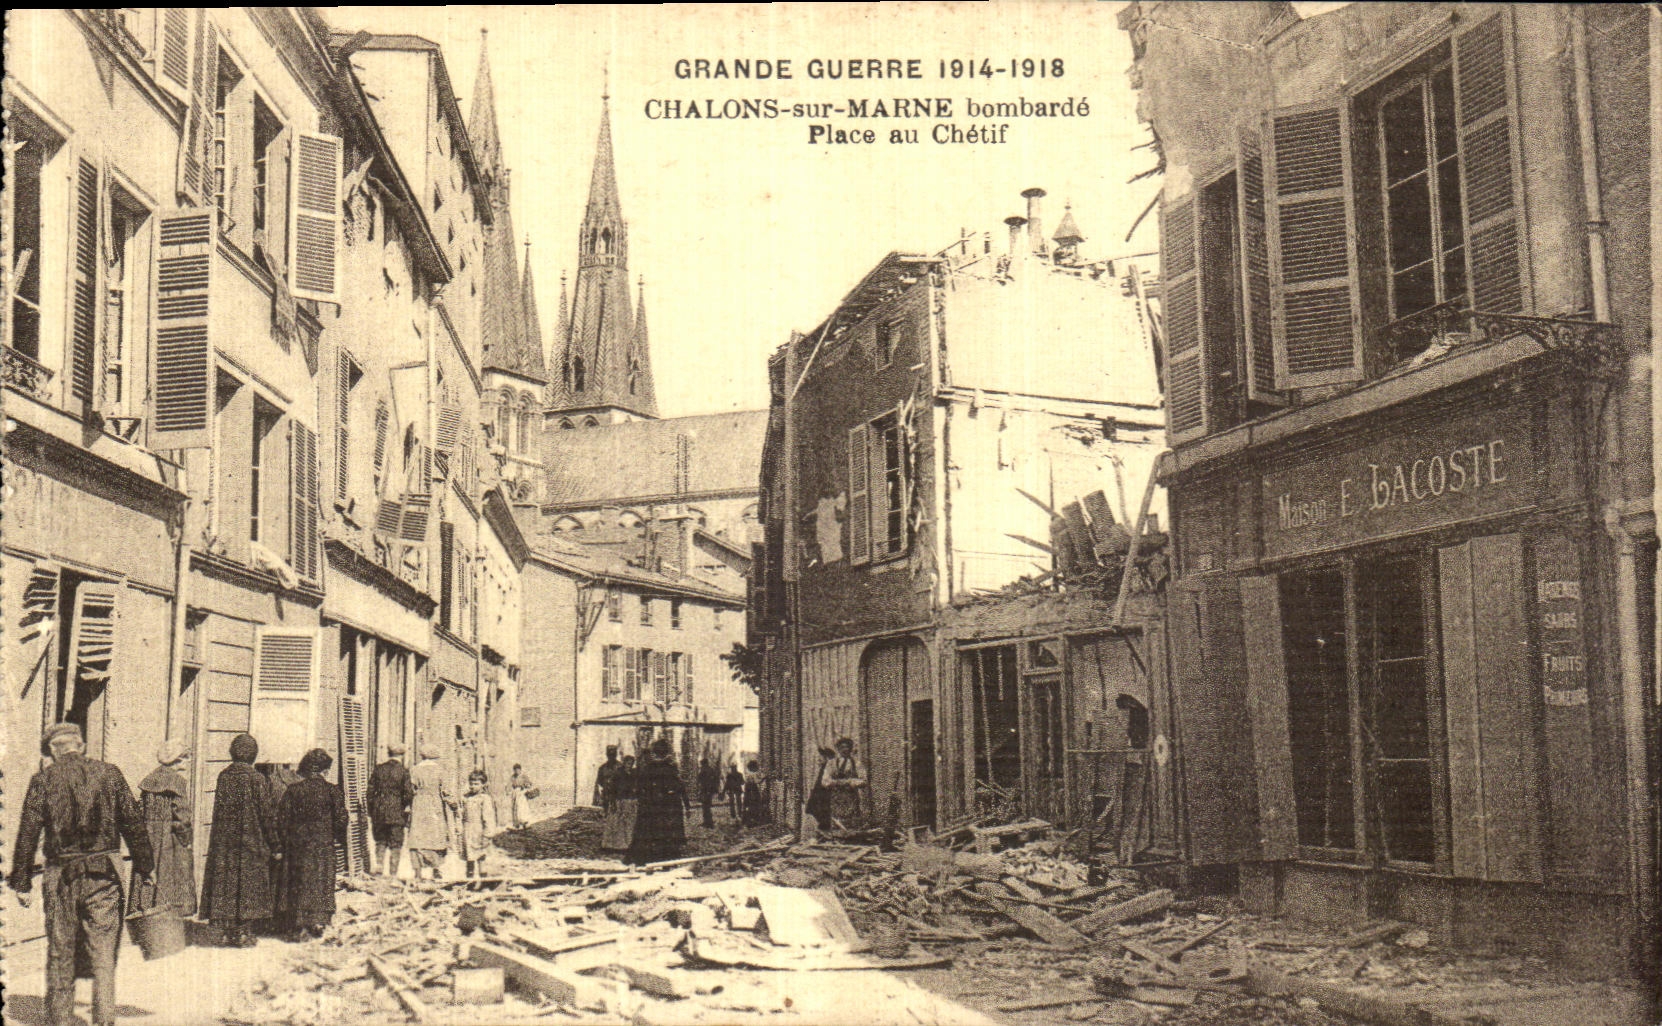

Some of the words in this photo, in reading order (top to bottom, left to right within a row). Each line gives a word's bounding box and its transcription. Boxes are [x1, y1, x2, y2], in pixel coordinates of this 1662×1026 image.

[1278, 492, 1328, 530] Maison
[1368, 440, 1507, 511] LACOSTE
[1542, 653, 1586, 672] FRUITS
